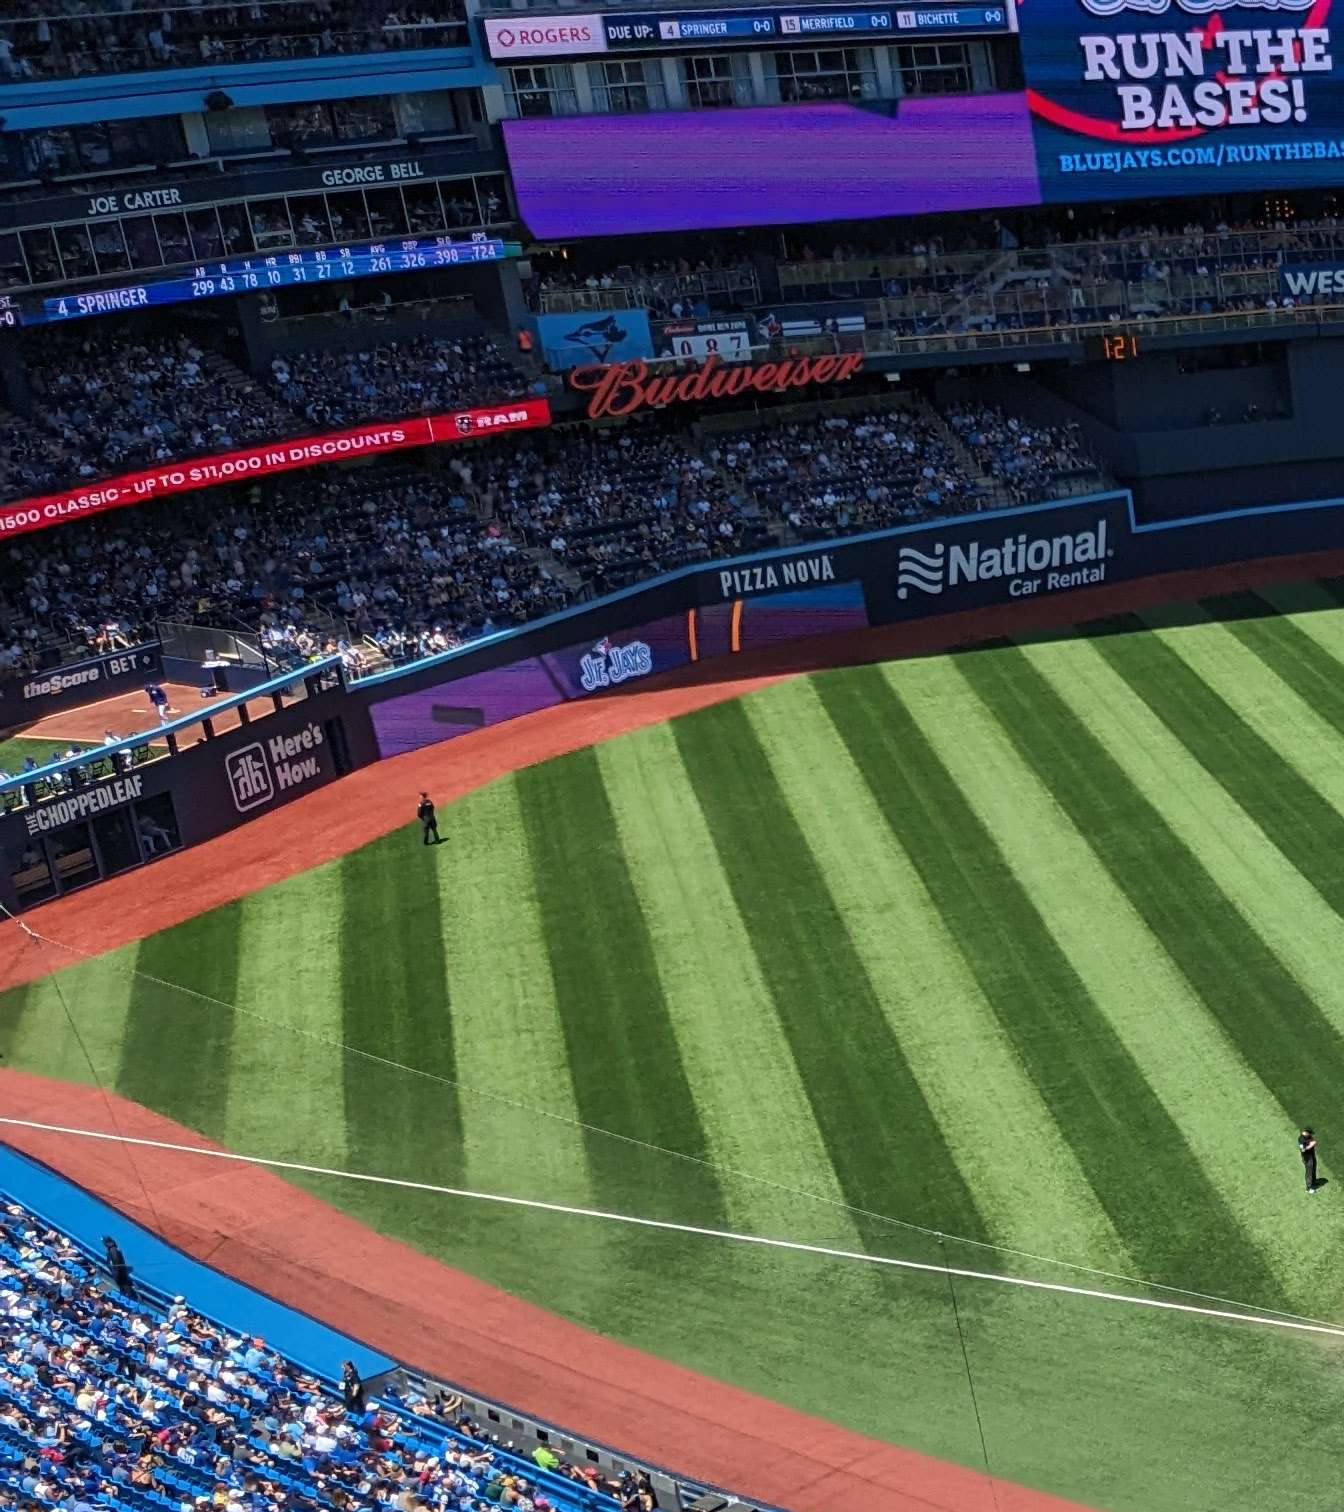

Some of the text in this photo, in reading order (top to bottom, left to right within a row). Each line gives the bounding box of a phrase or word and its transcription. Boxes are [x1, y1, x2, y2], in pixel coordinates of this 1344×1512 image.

[608, 23, 654, 39] DUE UP:
[667, 20, 771, 36] 4 SPRINGER 0-0
[785, 15, 887, 32] 15 MERRIFIELD 0-0
[902, 11, 1001, 26] 11 BICHETTE 0-0
[520, 27, 592, 46] ROGERS
[1080, 28, 1333, 80] RUN THE
[1117, 79, 1309, 130] BASES!
[322, 161, 425, 187] GEORGE BELL
[88, 188, 183, 217] JOE CARTER
[58, 245, 497, 317] 4 SPRINGER 299 43 78 10 31 27 12 .261 .326 .398 .724
[569, 344, 865, 420] Budweiser
[476, 410, 528, 429] RAM
[43, 486, 120, 520] CLASSIC
[133, 476, 158, 497] UP
[159, 471, 186, 488] TO
[188, 456, 263, 484] $11,000
[265, 451, 286, 468] IN
[288, 429, 406, 464] DISCOUNTS
[949, 519, 1110, 586] National
[720, 554, 835, 598] PIZZA NOVA
[1010, 563, 1106, 597] Car Rental
[23, 655, 138, 700] theScore BET
[268, 721, 324, 764] Here's
[274, 757, 323, 791] How.
[36, 774, 143, 833] CHOPPEDLEAF
[25, 811, 40, 836] THE
